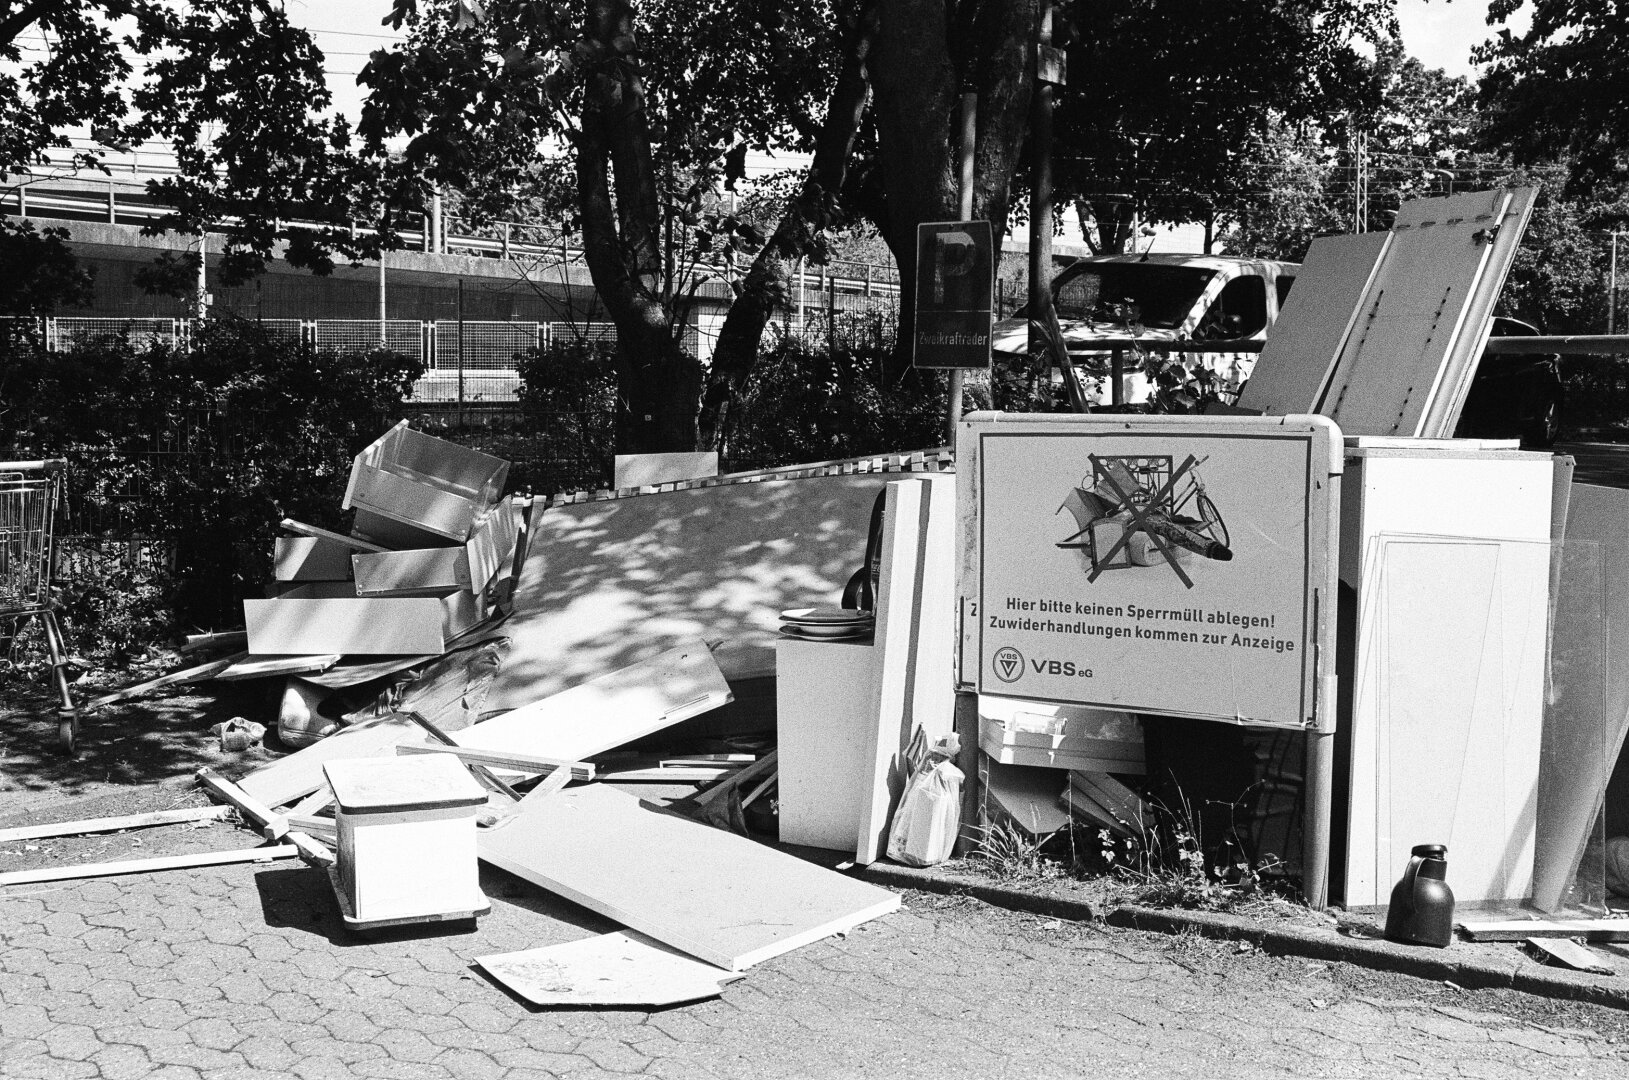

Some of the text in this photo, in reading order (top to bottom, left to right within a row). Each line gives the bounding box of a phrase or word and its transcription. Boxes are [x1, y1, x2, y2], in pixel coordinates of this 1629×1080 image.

[935, 231, 976, 304] P
[1006, 597, 1275, 629] Hier bitte keinen Sperrmüll ablegen!
[990, 615, 1295, 653] Zuwiderhandlungen kommen zur Anzeige
[1031, 658, 1093, 678] VBS eG
